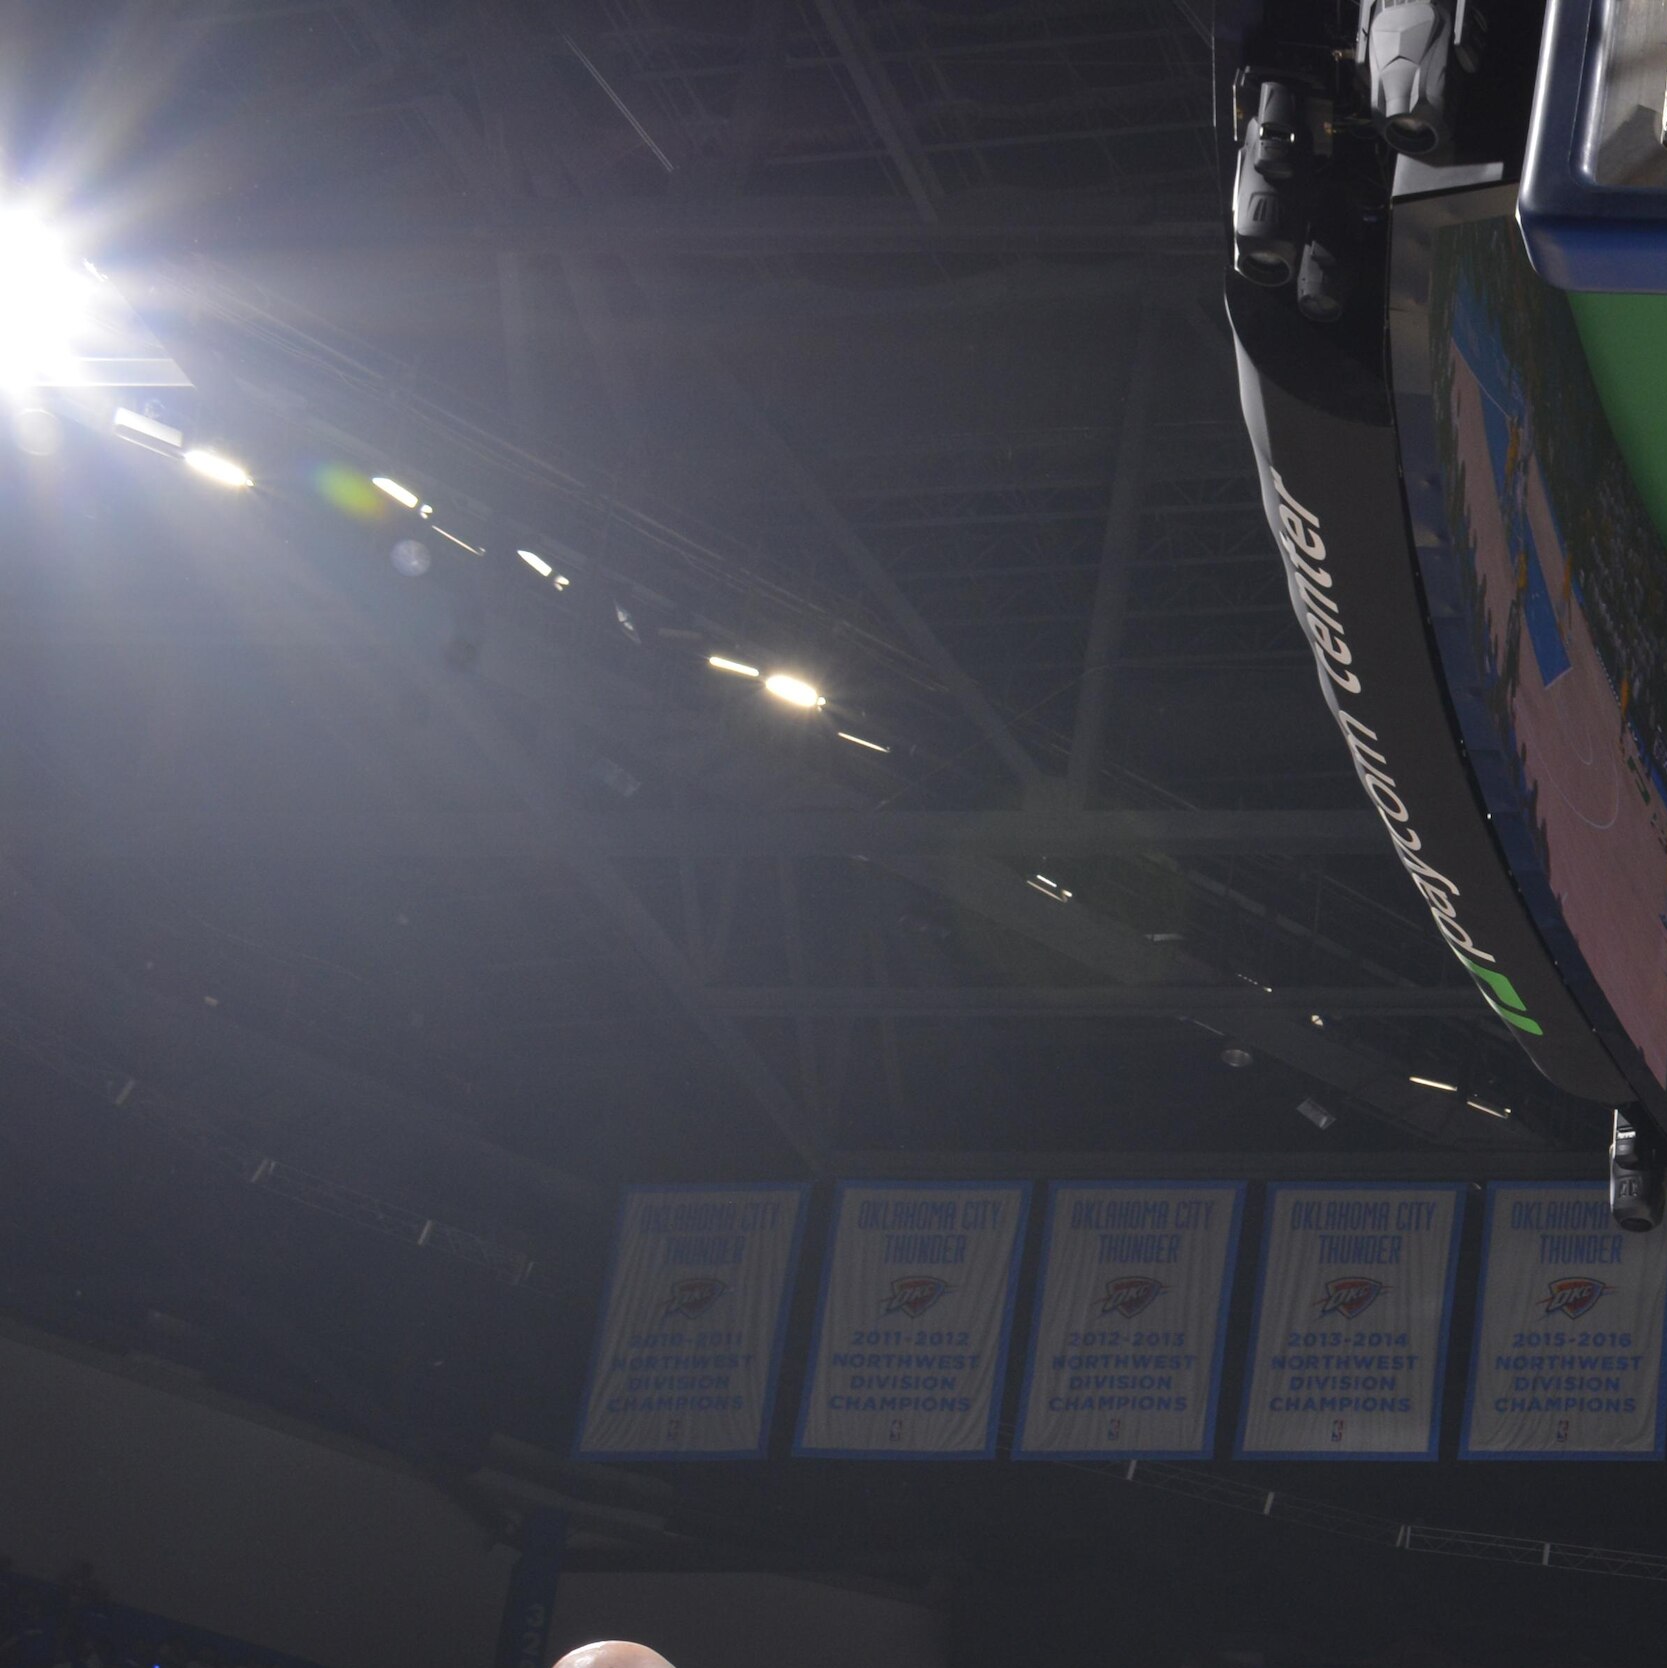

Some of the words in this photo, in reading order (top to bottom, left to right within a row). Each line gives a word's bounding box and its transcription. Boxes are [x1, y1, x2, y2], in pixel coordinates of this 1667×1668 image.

[1270, 467, 1361, 694] center
[1338, 710, 1496, 963] paycom
[1291, 1200, 1392, 1232] OKLAHOMA
[1318, 1234, 1402, 1265] THUNDER
[1540, 1234, 1624, 1265] THUNDER
[832, 1354, 980, 1370] NORTHWEST
[1051, 1354, 1197, 1371] NORTHWEST
[1270, 1355, 1419, 1372] NORTHWEST
[1495, 1355, 1644, 1372] NORTHWEST
[850, 1375, 956, 1391] DIVISION
[1068, 1376, 1173, 1391] DIVISION
[1289, 1375, 1397, 1393] DIVISION
[1513, 1375, 1621, 1393] DIVISION
[828, 1396, 972, 1413] CHAMPIONS
[1048, 1396, 1188, 1413] CHAMPIONS
[1269, 1397, 1412, 1414] CHAMPIONS
[1492, 1397, 1637, 1414] CHAMPIONS
